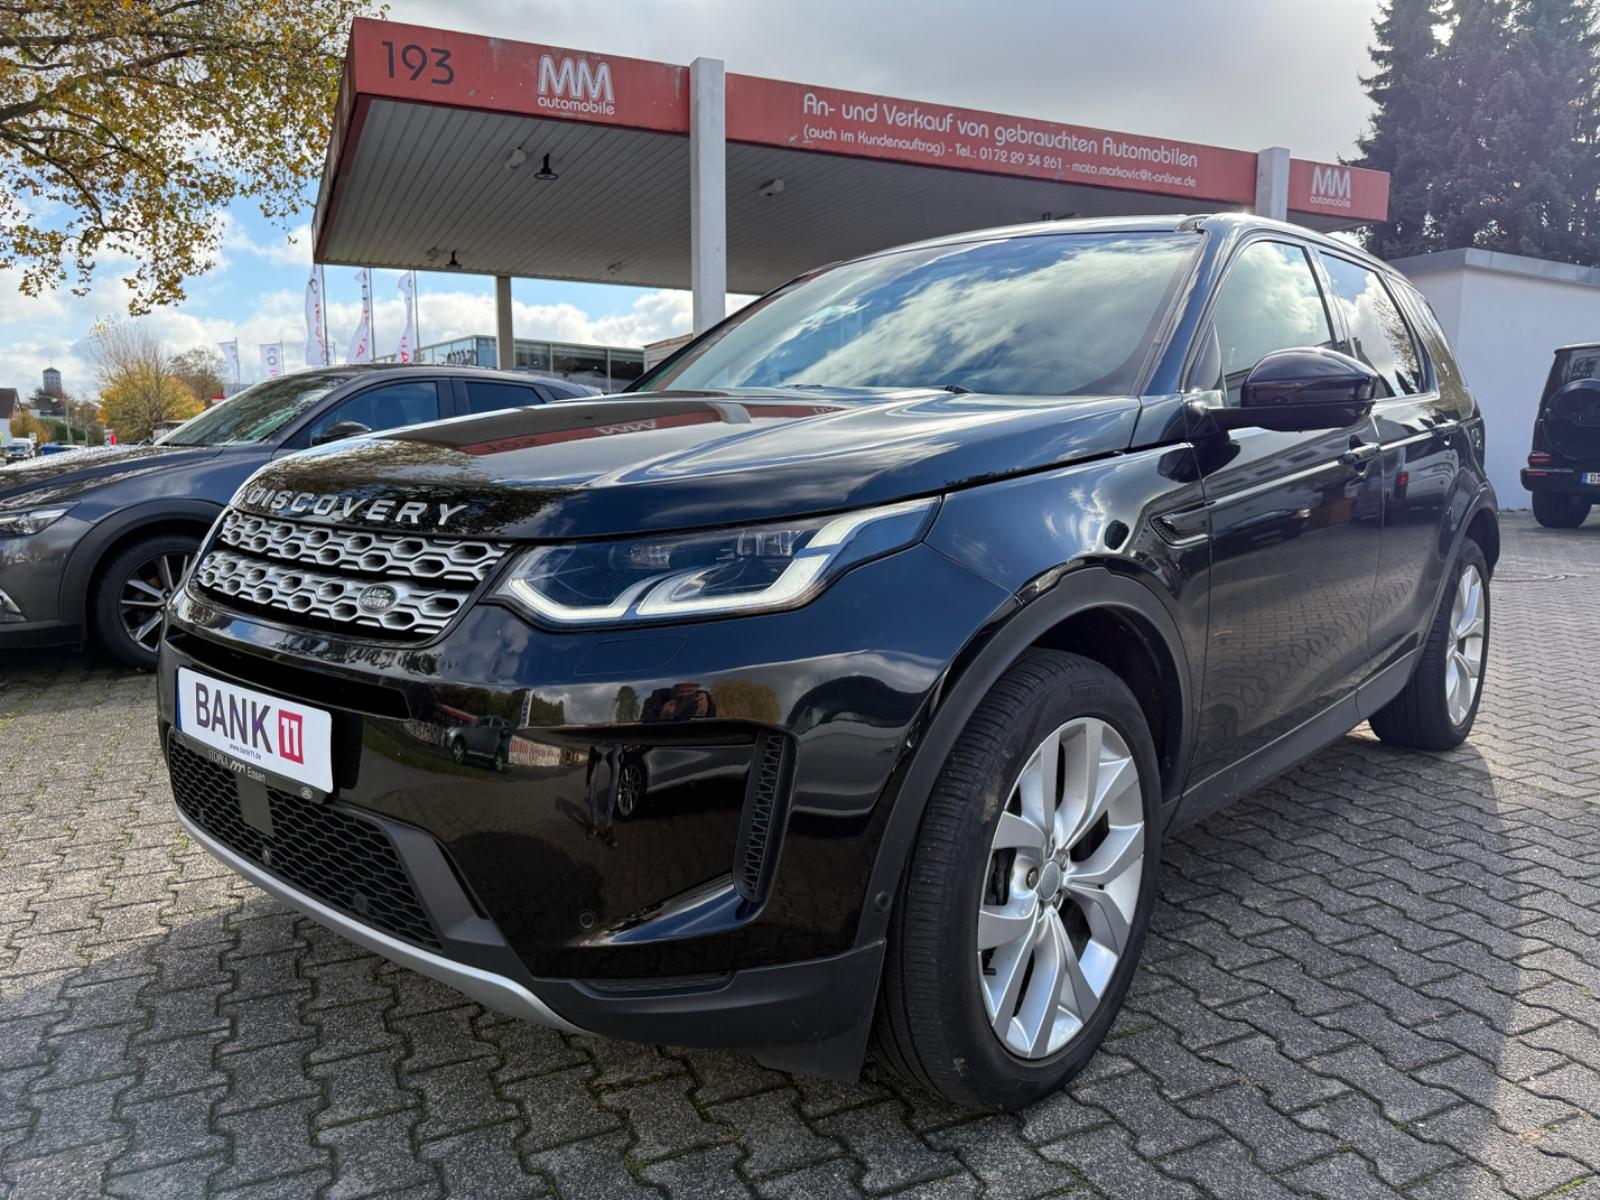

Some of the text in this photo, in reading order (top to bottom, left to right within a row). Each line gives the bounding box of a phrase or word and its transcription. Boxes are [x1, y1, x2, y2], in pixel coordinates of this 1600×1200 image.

[381, 41, 455, 85] 193
[537, 54, 614, 103] MM
[537, 96, 615, 116] automobile
[803, 92, 1198, 168] An- und Verkauf von gebrauchten Automobilen
[803, 124, 837, 140] (auch
[840, 129, 855, 143] im
[857, 131, 945, 157] Kundenauftrag)
[979, 147, 1007, 163] 0172
[1010, 151, 1025, 165] 29
[1027, 153, 1040, 167] 34
[1043, 156, 1062, 170] 261
[1310, 195, 1351, 208] automobile
[1311, 165, 1351, 199] MM
[247, 487, 468, 526] DISCOVERY
[195, 681, 273, 754] BANK
[247, 767, 266, 783] Essen
